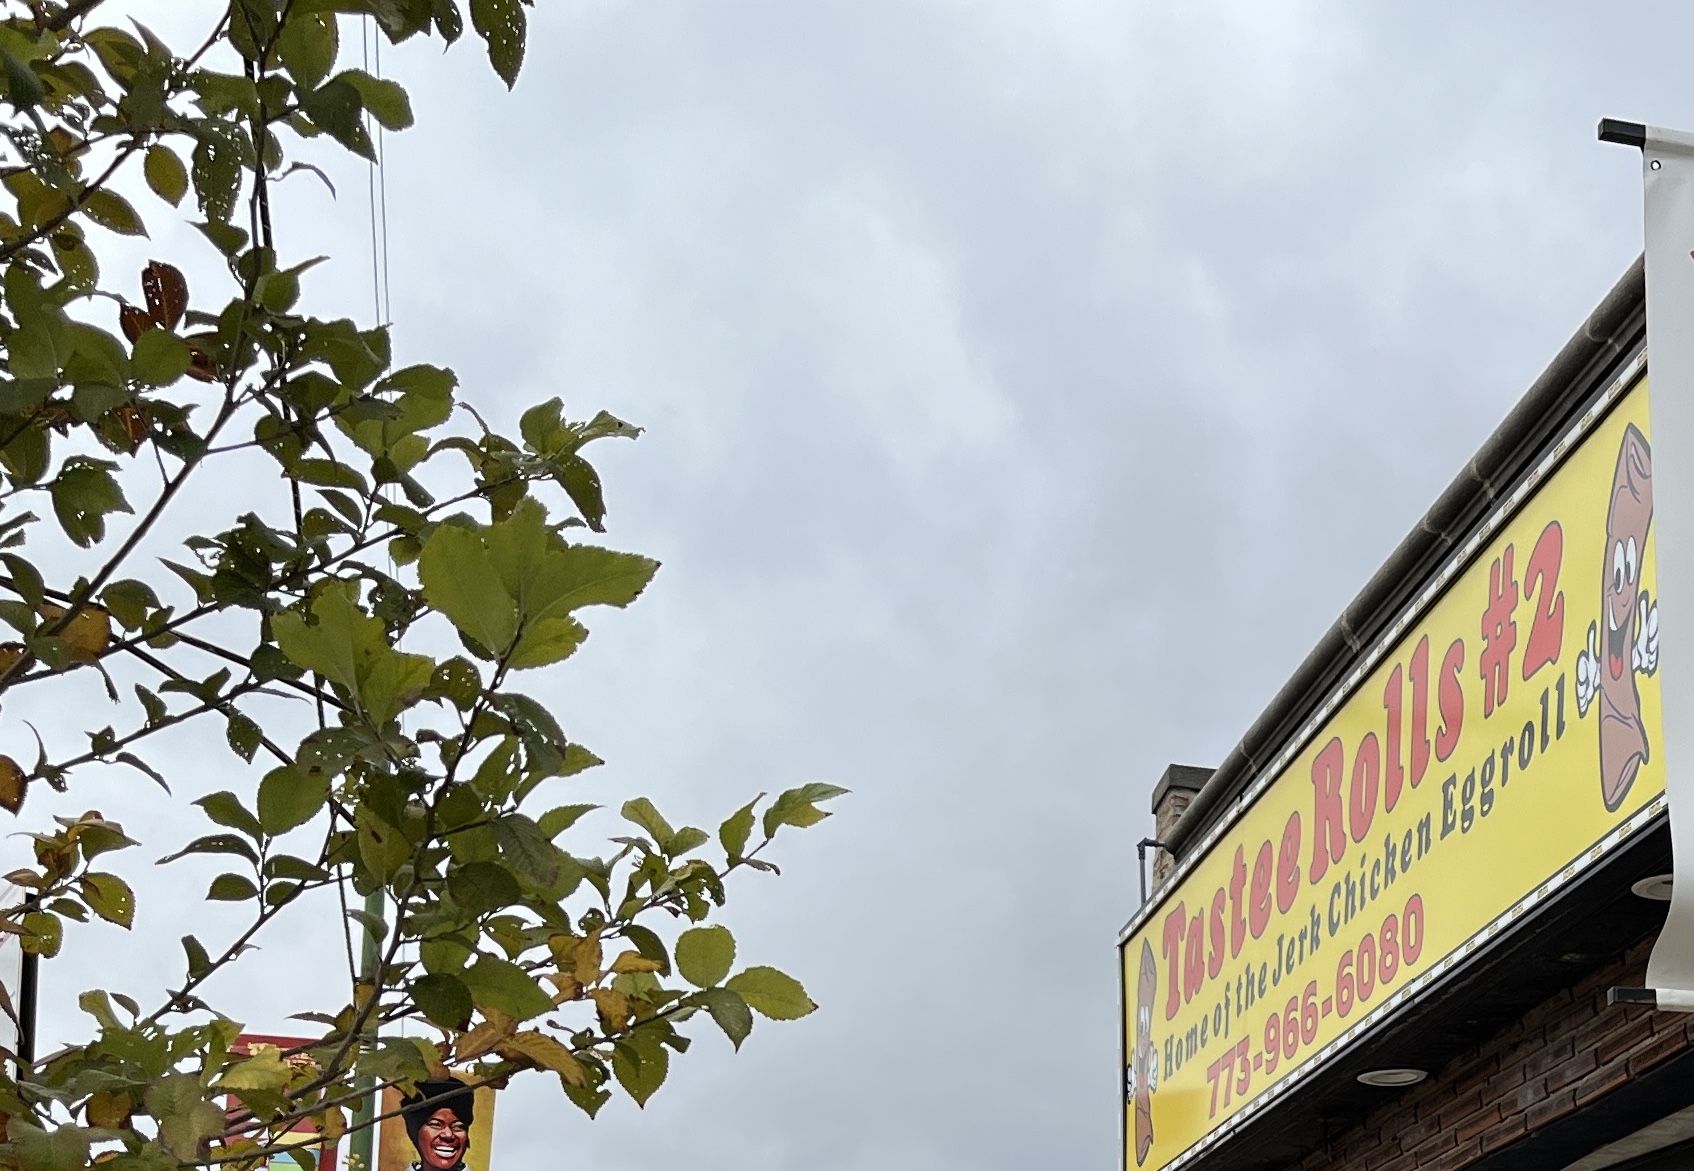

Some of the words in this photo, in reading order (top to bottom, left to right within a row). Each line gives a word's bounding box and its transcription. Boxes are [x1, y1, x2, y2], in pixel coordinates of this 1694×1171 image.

[1163, 810, 1300, 1021] Tastee
[1309, 634, 1465, 885] Rolls
[1480, 520, 1565, 720] #2
[1164, 1014, 1209, 1081] Home
[1213, 981, 1231, 1040] of
[1236, 961, 1268, 1018] the
[1272, 904, 1321, 987] Jerk
[1328, 811, 1432, 937] Chicken
[1440, 672, 1566, 841] Eggroll
[1207, 893, 1424, 1120] 773-966-6080
